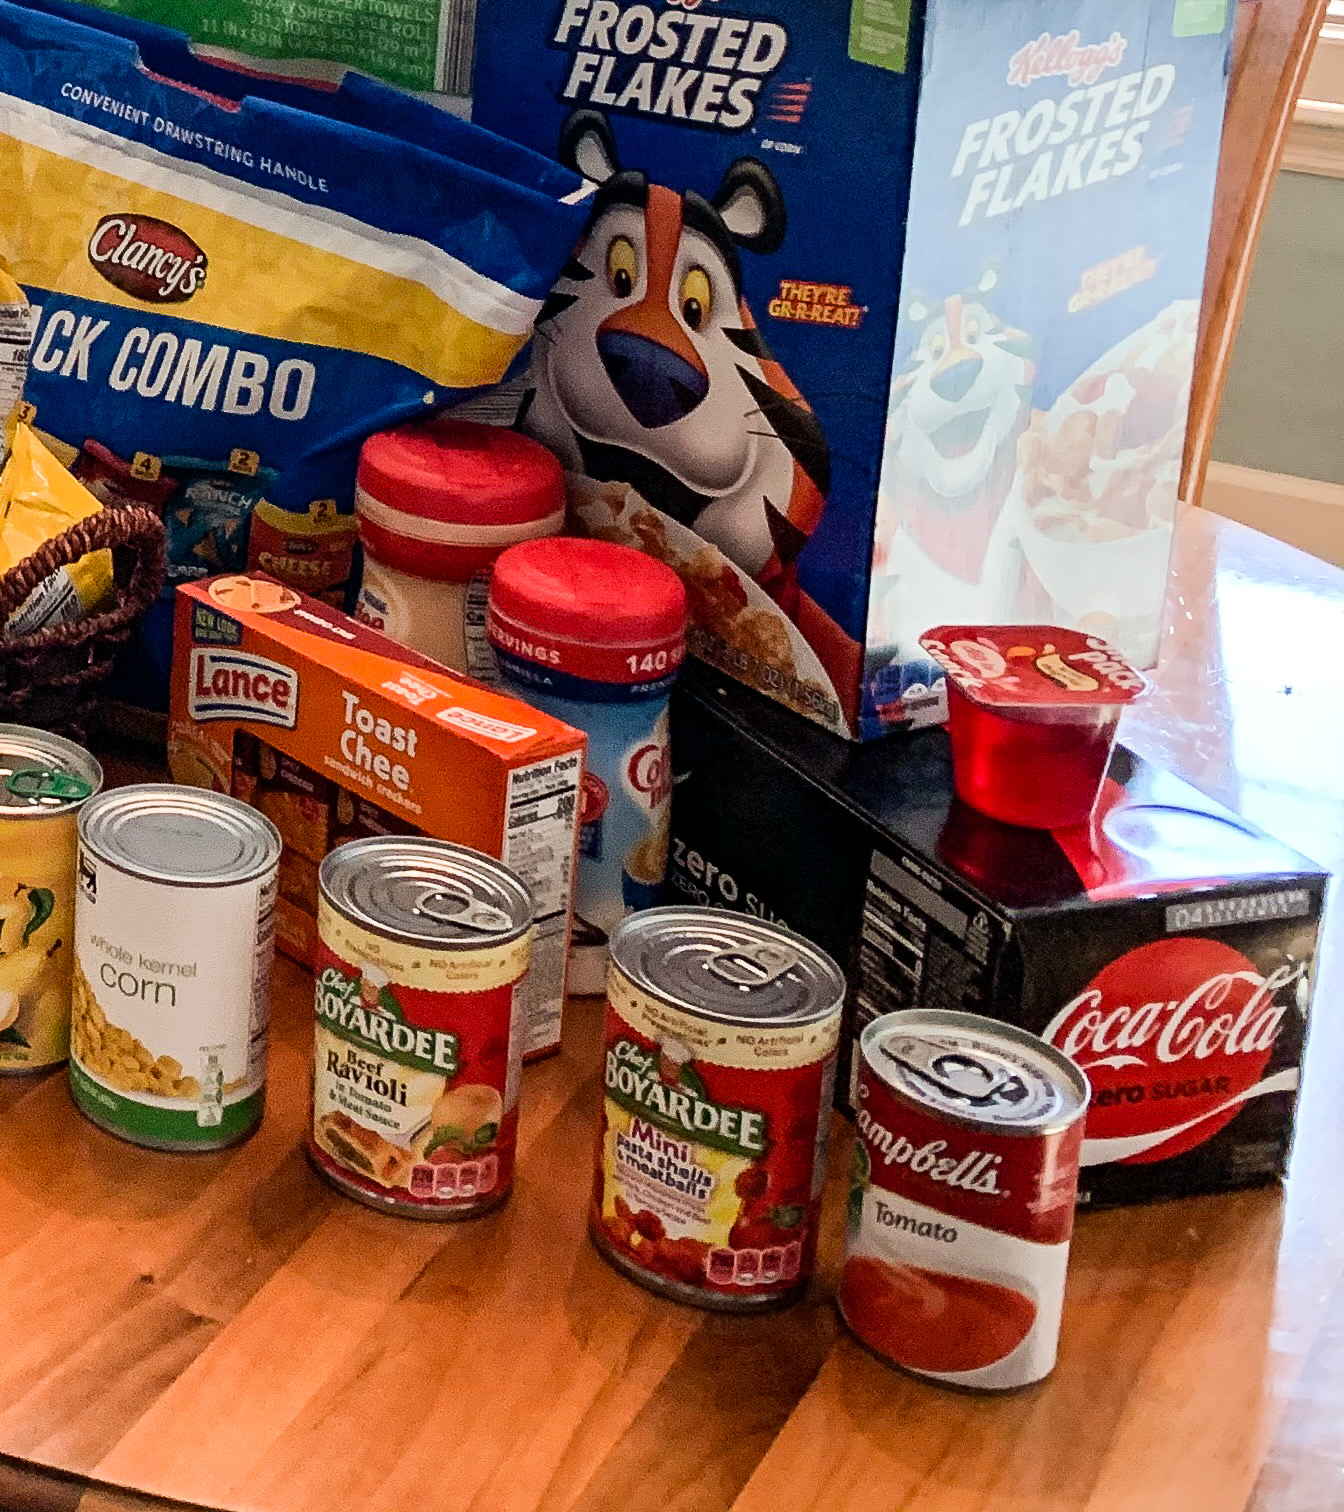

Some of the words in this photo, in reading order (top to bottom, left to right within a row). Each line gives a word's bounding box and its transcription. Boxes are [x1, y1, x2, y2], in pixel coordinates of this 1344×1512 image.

[297, 4, 355, 26] SHEETS
[391, 22, 432, 40] ROLL
[1006, 29, 1128, 88] Kellogg's
[562, 51, 763, 130] FLAKES
[60, 80, 151, 128] CONVENIENT
[153, 116, 256, 173] DRAWSTRING
[258, 155, 331, 194] HANDLE
[949, 63, 1176, 179] FROSTED
[957, 120, 1153, 229] FLAKES
[89, 218, 208, 298] Clancy's
[780, 281, 850, 306] THEY'RE
[108, 324, 317, 422] COMBO
[18, 405, 31, 420] 3
[139, 457, 153, 473] 4
[238, 451, 251, 467] 2
[184, 486, 254, 509] RANCH
[317, 501, 329, 518] 2
[257, 552, 335, 576] CHEESE
[195, 611, 216, 628] NEW
[490, 625, 561, 665] ERVINGS
[626, 650, 668, 676] 140
[194, 652, 291, 709] Lance
[341, 689, 417, 758] Toast
[340, 730, 410, 789] Chee
[512, 764, 552, 784] Nutrition
[553, 756, 578, 773] Facts
[323, 755, 373, 789] sandwich
[375, 782, 423, 815] crackers
[672, 837, 739, 903] zero
[90, 933, 133, 966] whole
[138, 953, 198, 979] kernel
[99, 962, 177, 1008] corn
[321, 967, 356, 1000] Chef
[315, 979, 457, 1071] BOYARDEE
[1040, 964, 1290, 1064] Coca-Cola
[615, 1040, 654, 1075] Chef
[735, 1034, 755, 1045] NO
[326, 1049, 408, 1108] Ravioli
[347, 1049, 385, 1077] Beef
[349, 1085, 392, 1114] Tomato
[605, 1050, 765, 1152] BOYARDEE
[1096, 1084, 1145, 1108] ero
[1151, 1075, 1231, 1100] SUGAR
[631, 1116, 690, 1163] Mini
[625, 1154, 707, 1201] meatballs
[656, 1154, 713, 1187] shells
[873, 1199, 959, 1245] Tomato
